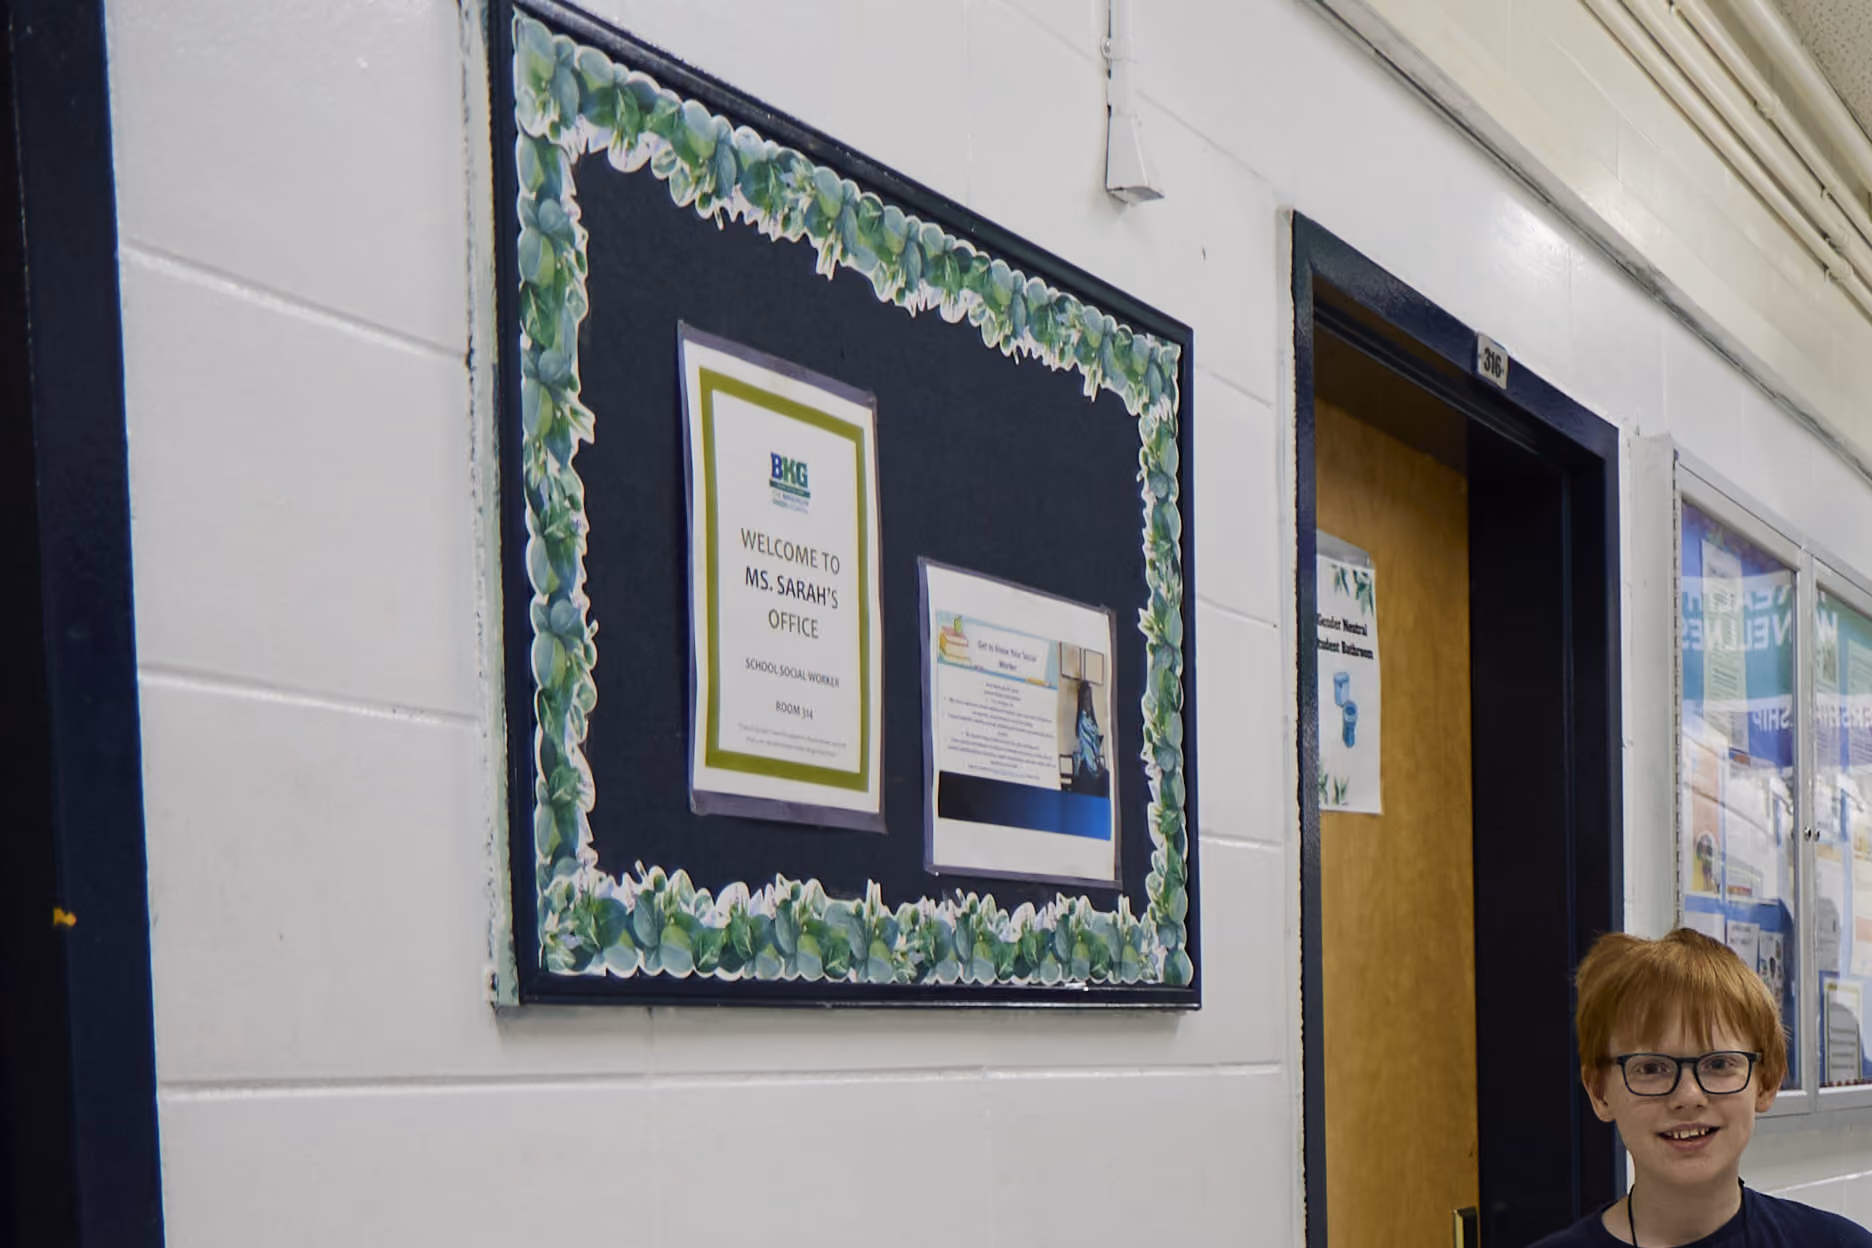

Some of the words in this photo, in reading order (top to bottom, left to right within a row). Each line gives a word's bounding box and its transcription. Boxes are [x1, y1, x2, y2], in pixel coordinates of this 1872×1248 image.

[1483, 347, 1502, 378] 316
[770, 452, 808, 489] BKG
[741, 528, 818, 568] WELCOME
[822, 552, 840, 574] TO
[745, 566, 773, 591] MS.
[777, 575, 838, 609] SARAH'S
[768, 608, 818, 639] OFFICE
[745, 657, 778, 675] SCHOOL
[779, 664, 806, 680] SOCIAL
[807, 671, 839, 688] WORKER
[776, 700, 800, 715] ROOM
